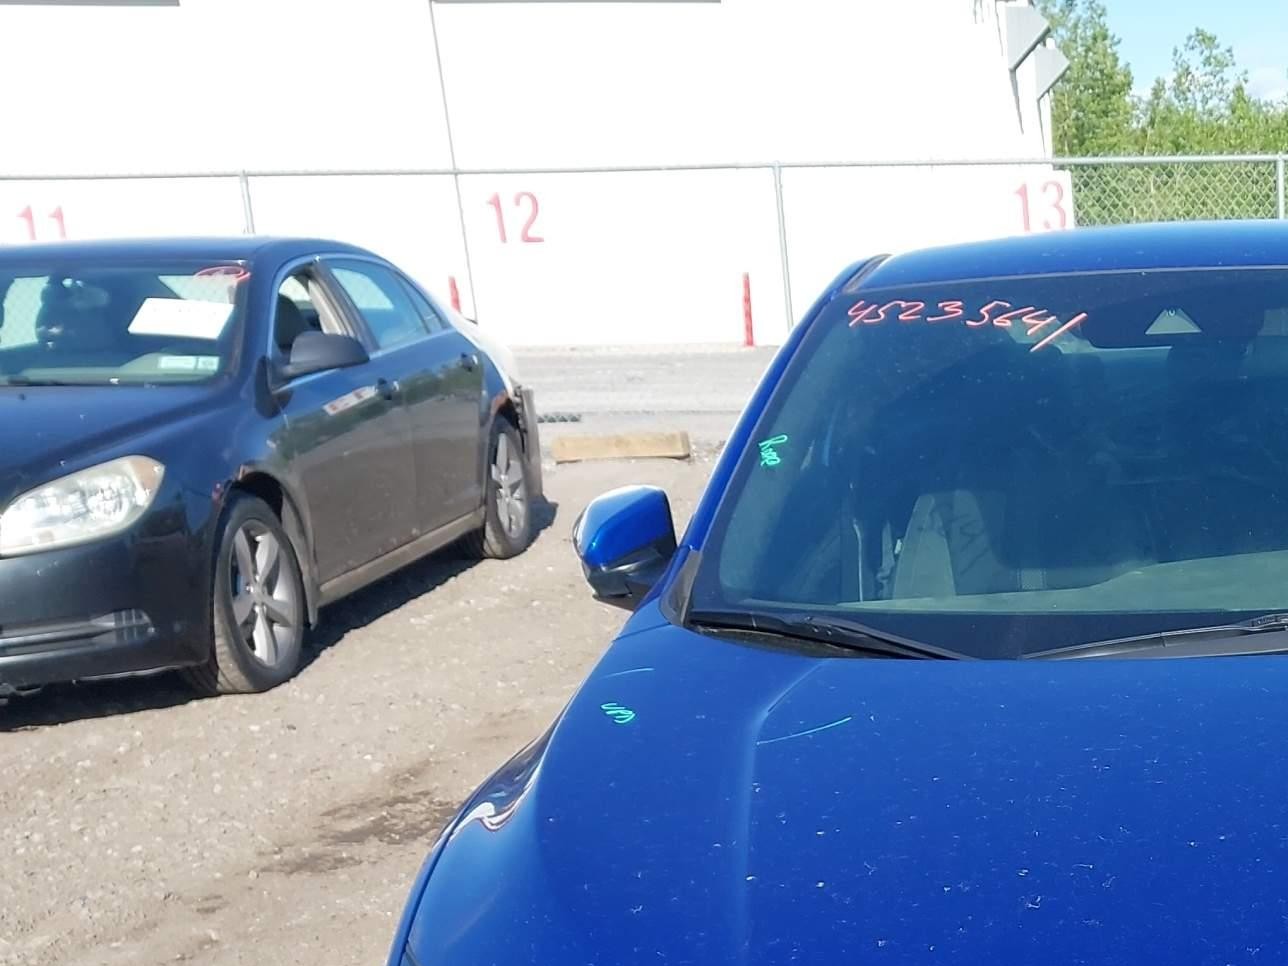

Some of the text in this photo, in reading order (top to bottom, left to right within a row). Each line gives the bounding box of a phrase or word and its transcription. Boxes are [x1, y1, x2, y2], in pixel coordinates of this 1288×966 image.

[16, 205, 67, 240] 11
[486, 192, 544, 243] 12
[1014, 181, 1067, 231] 13
[847, 300, 1087, 352] 45235641
